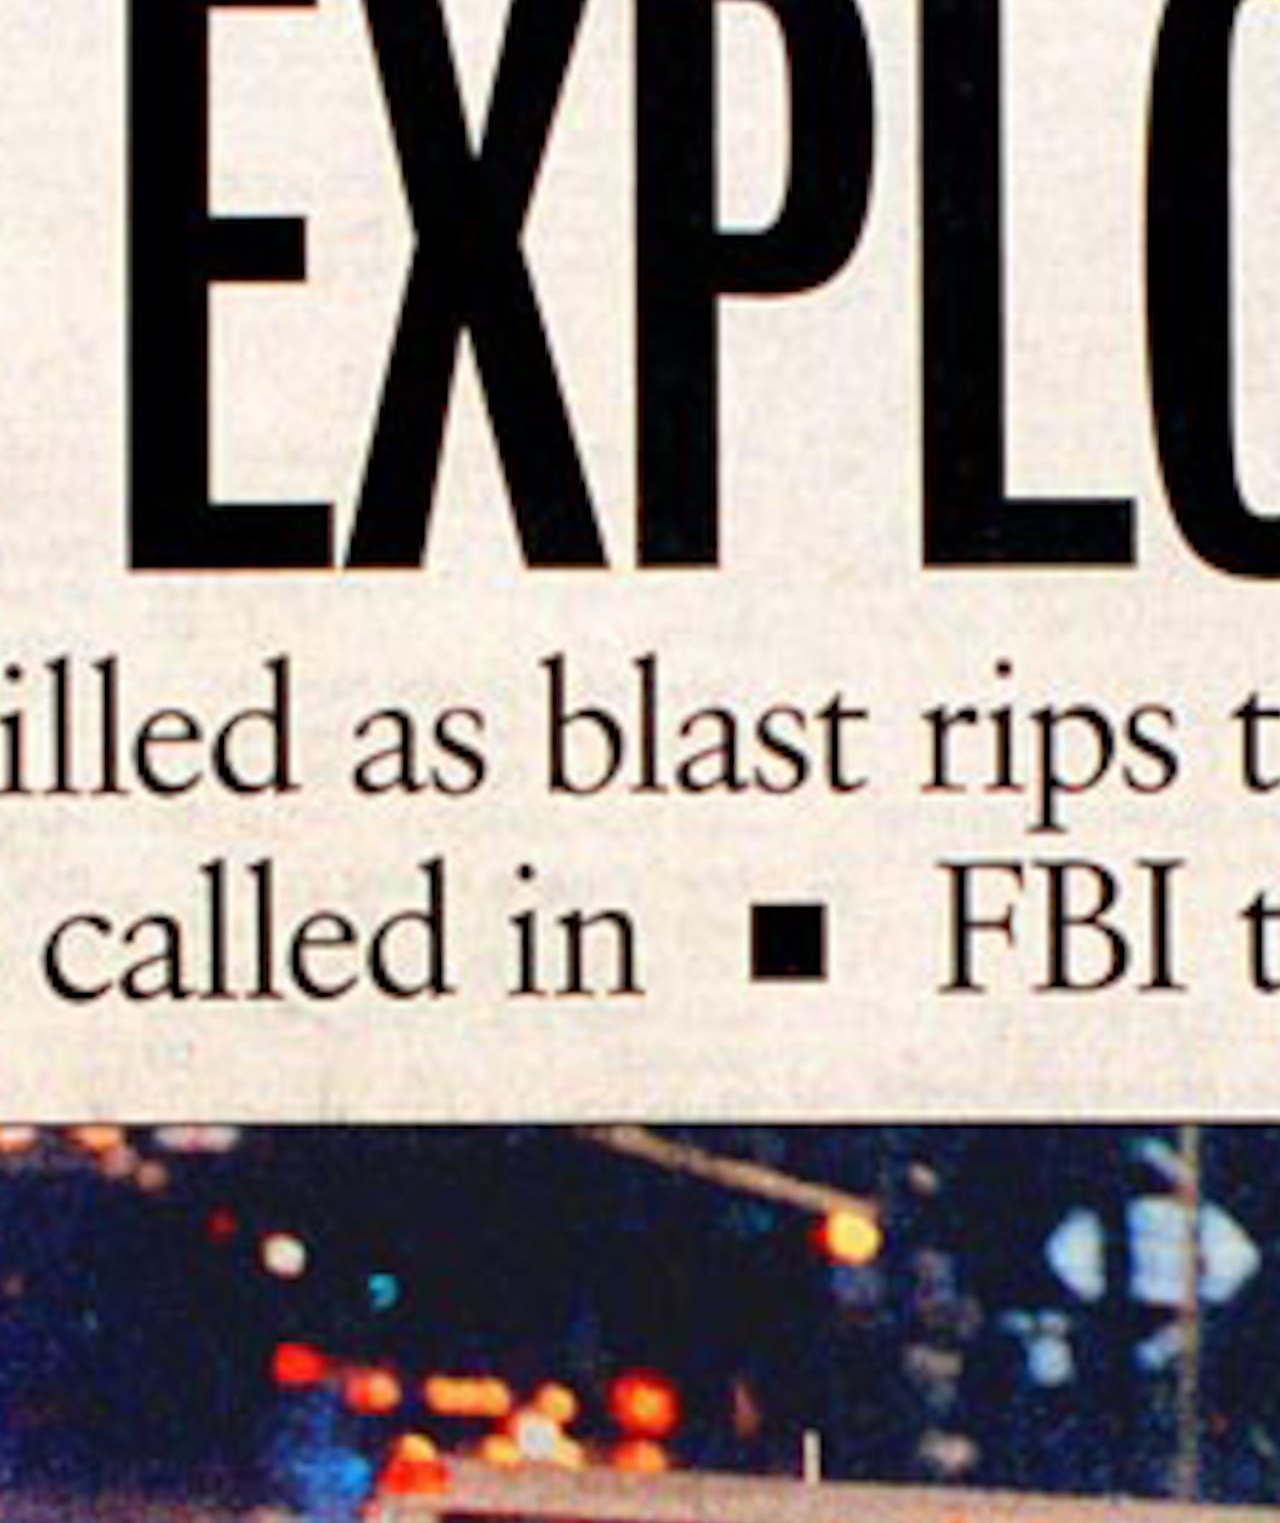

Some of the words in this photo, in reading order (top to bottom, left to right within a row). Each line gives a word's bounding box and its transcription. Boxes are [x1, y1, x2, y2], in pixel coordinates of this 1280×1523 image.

[354, 709, 485, 795] as
[545, 652, 866, 794] blast
[925, 663, 1177, 833] rips
[44, 858, 448, 1003] called
[512, 863, 637, 995] in
[942, 860, 1180, 992] FBI
